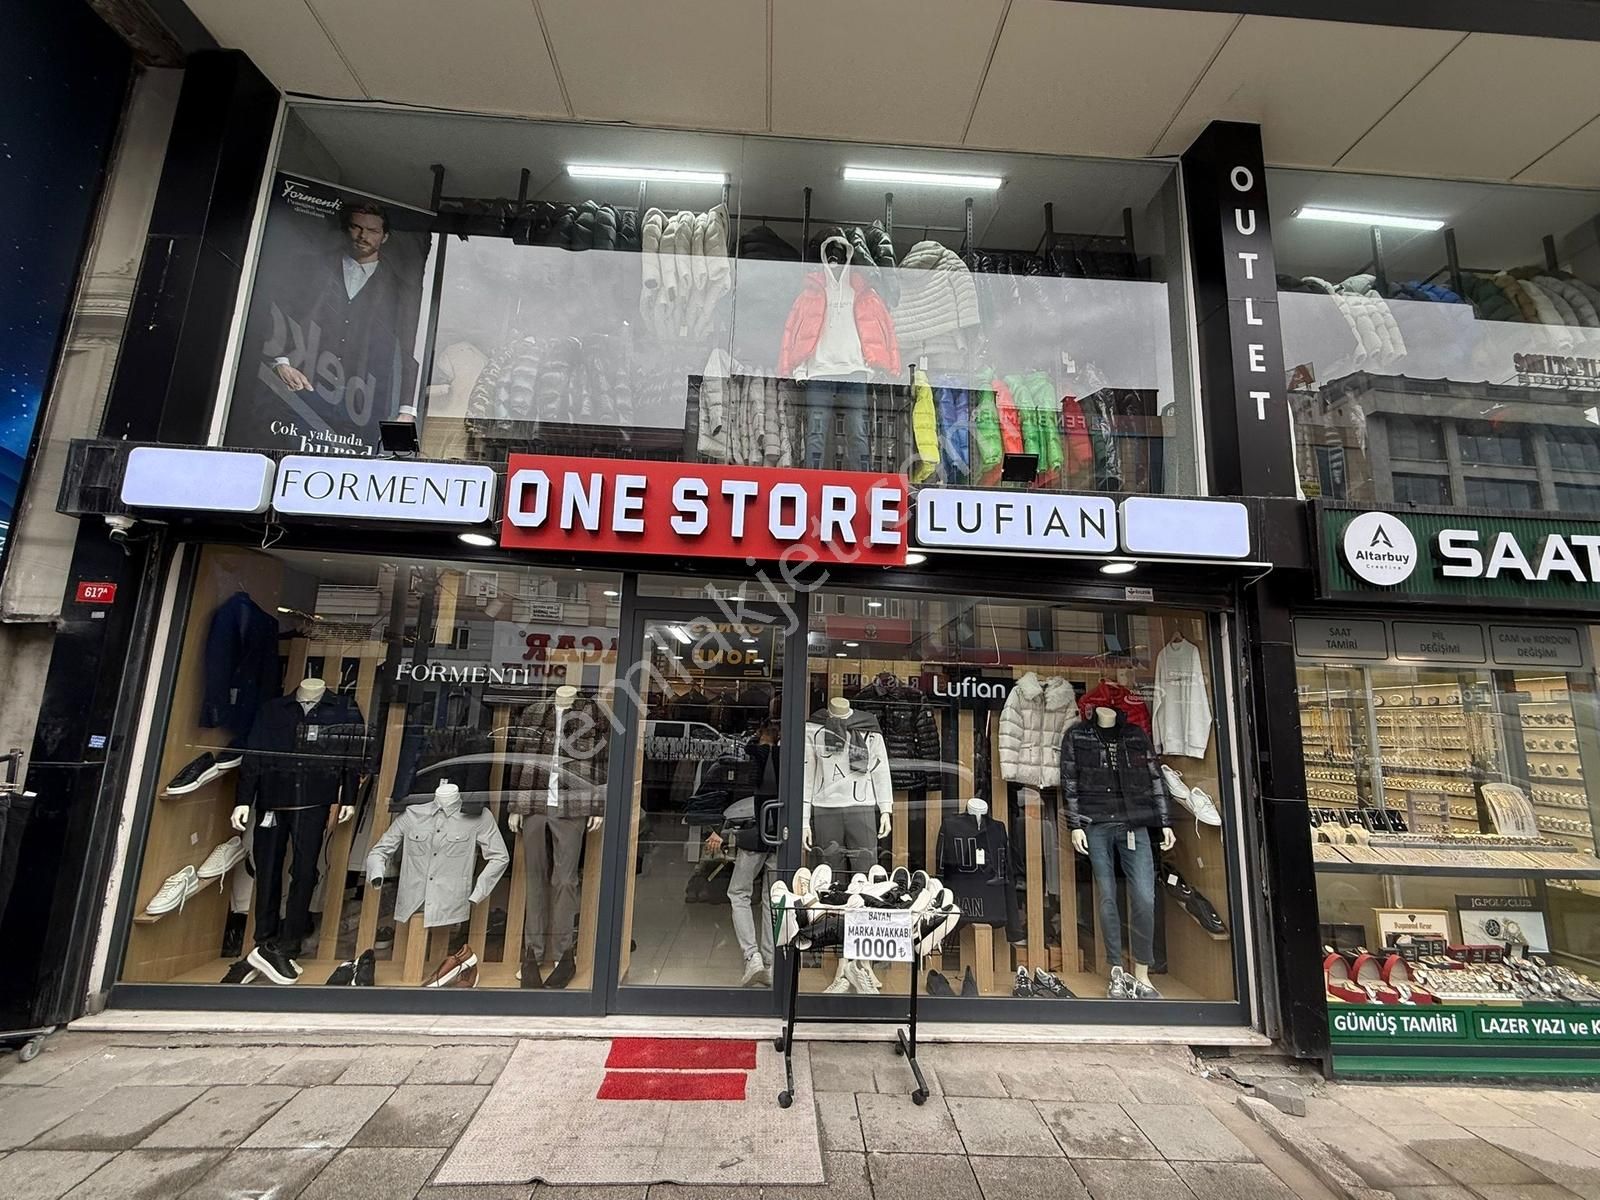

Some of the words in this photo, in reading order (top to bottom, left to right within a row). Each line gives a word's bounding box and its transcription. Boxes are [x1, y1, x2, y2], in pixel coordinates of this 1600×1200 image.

[282, 180, 342, 211] Formenti
[1230, 166, 1271, 420] OUTLET
[270, 420, 298, 437] Çok
[308, 429, 363, 447] yakında
[281, 469, 487, 509] FORMENTI
[507, 468, 647, 533] ONE
[670, 477, 902, 545] STORE
[929, 500, 1106, 540] LUFIAN
[1356, 550, 1410, 565] Altarbuy
[1438, 528, 1600, 583] SAAT
[1329, 627, 1353, 638] SAAT
[1498, 633, 1519, 643] CAM
[1521, 636, 1531, 644] ve
[1533, 635, 1571, 646] KORDON
[1325, 638, 1358, 650] TAMİRİ
[395, 664, 529, 685] FORMENTI
[933, 675, 1007, 699] Lufian
[868, 911, 892, 921] BAYAN
[848, 926, 875, 937] MARKA
[1334, 1013, 1397, 1035] GÜMÜŞ
[1400, 1013, 1458, 1033] TAMİRİ
[1480, 1017, 1529, 1034] LAZER
[1531, 1018, 1566, 1034] YAZI
[1569, 1022, 1588, 1035] ve
